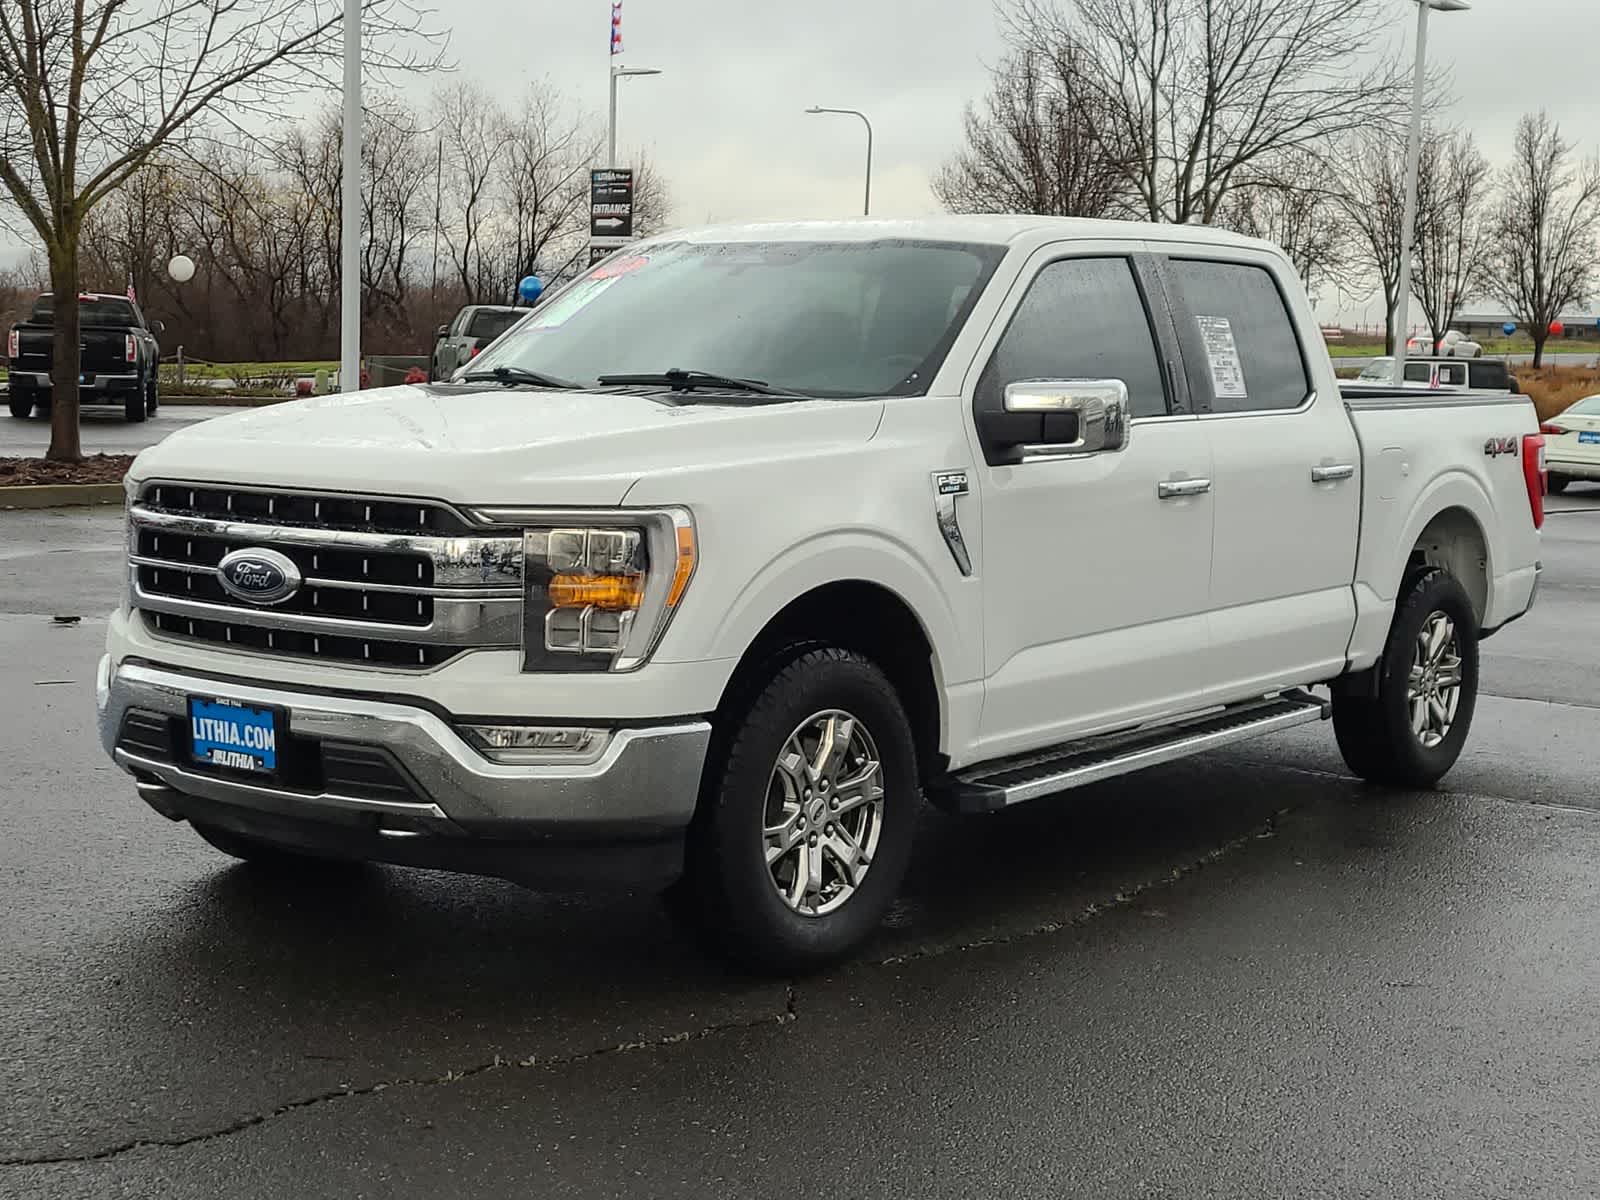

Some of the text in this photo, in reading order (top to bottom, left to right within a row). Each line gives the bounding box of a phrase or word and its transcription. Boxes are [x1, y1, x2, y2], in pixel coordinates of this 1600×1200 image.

[592, 204, 630, 214] ENTRANCE
[232, 562, 271, 587] Ford
[192, 717, 275, 752] LITHIA.COM
[222, 751, 254, 770] LITHIA
